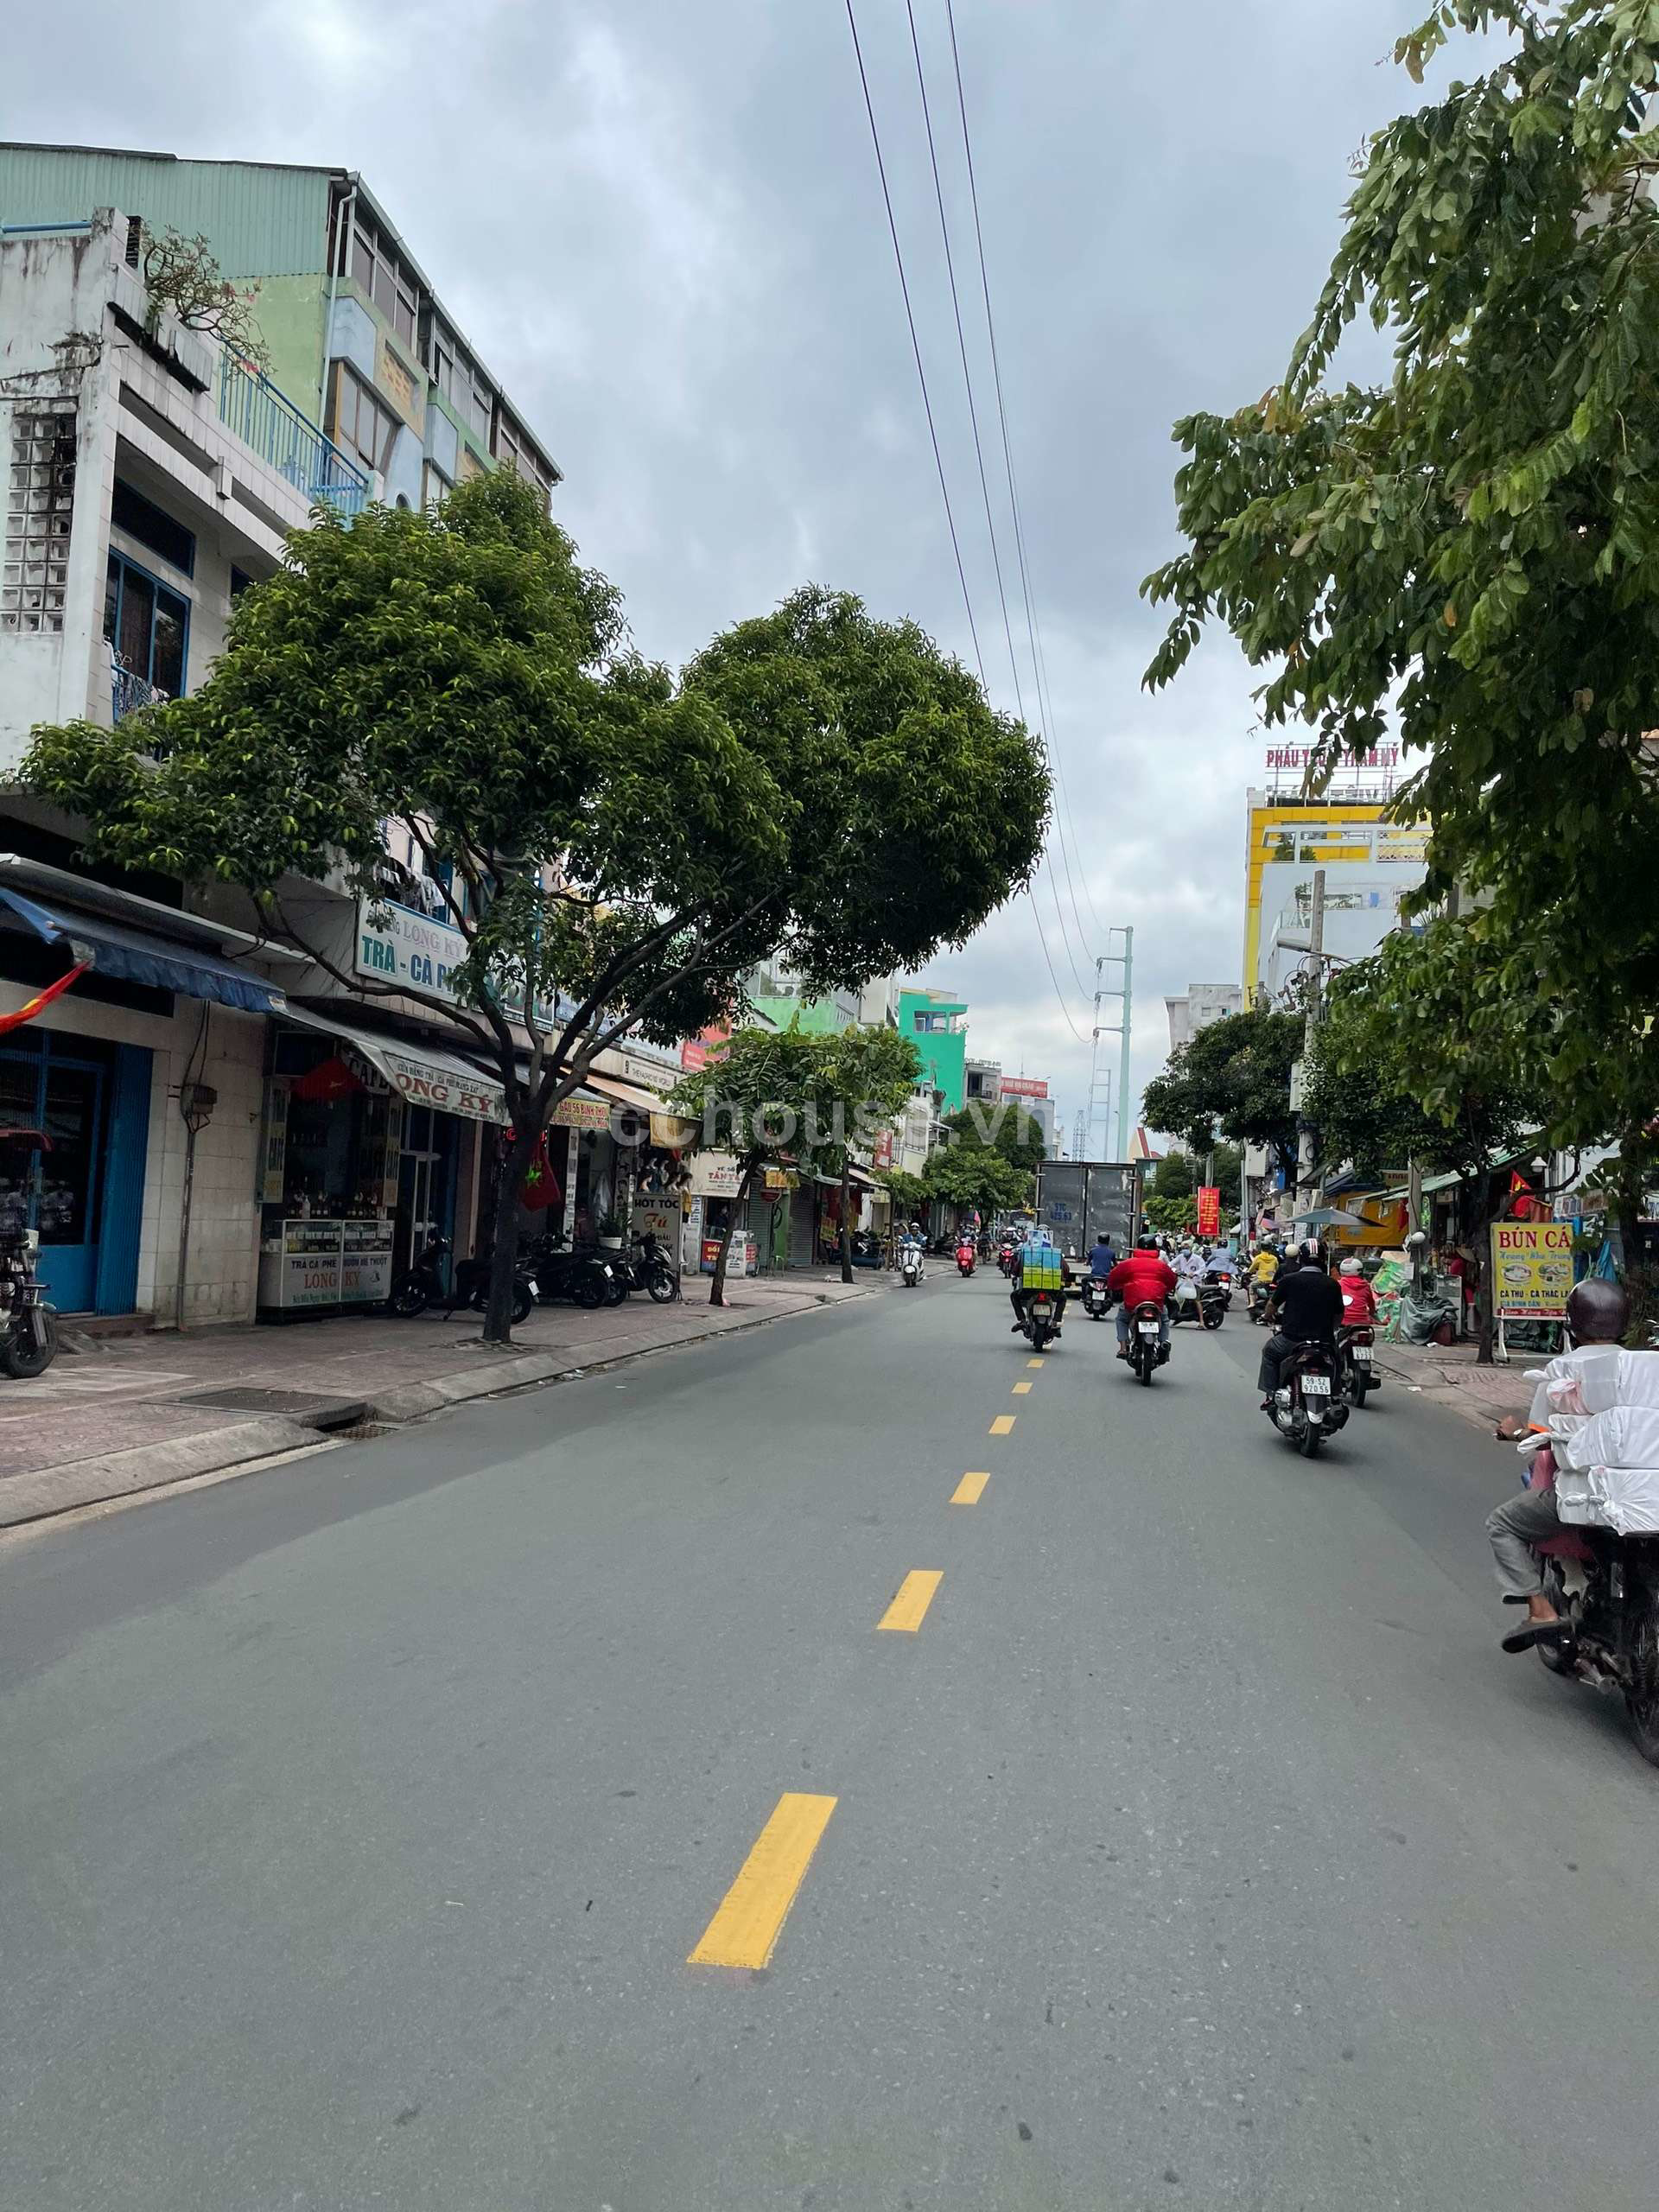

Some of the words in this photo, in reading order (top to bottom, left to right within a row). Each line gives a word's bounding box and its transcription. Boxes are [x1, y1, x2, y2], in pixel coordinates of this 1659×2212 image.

[404, 920, 441, 950] LONG
[362, 935, 396, 974] TRÀ
[410, 953, 433, 987] CÀ
[459, 1090, 494, 1114] KÝ
[1498, 1226, 1538, 1249] BÚN
[1545, 1225, 1572, 1249] CÁ
